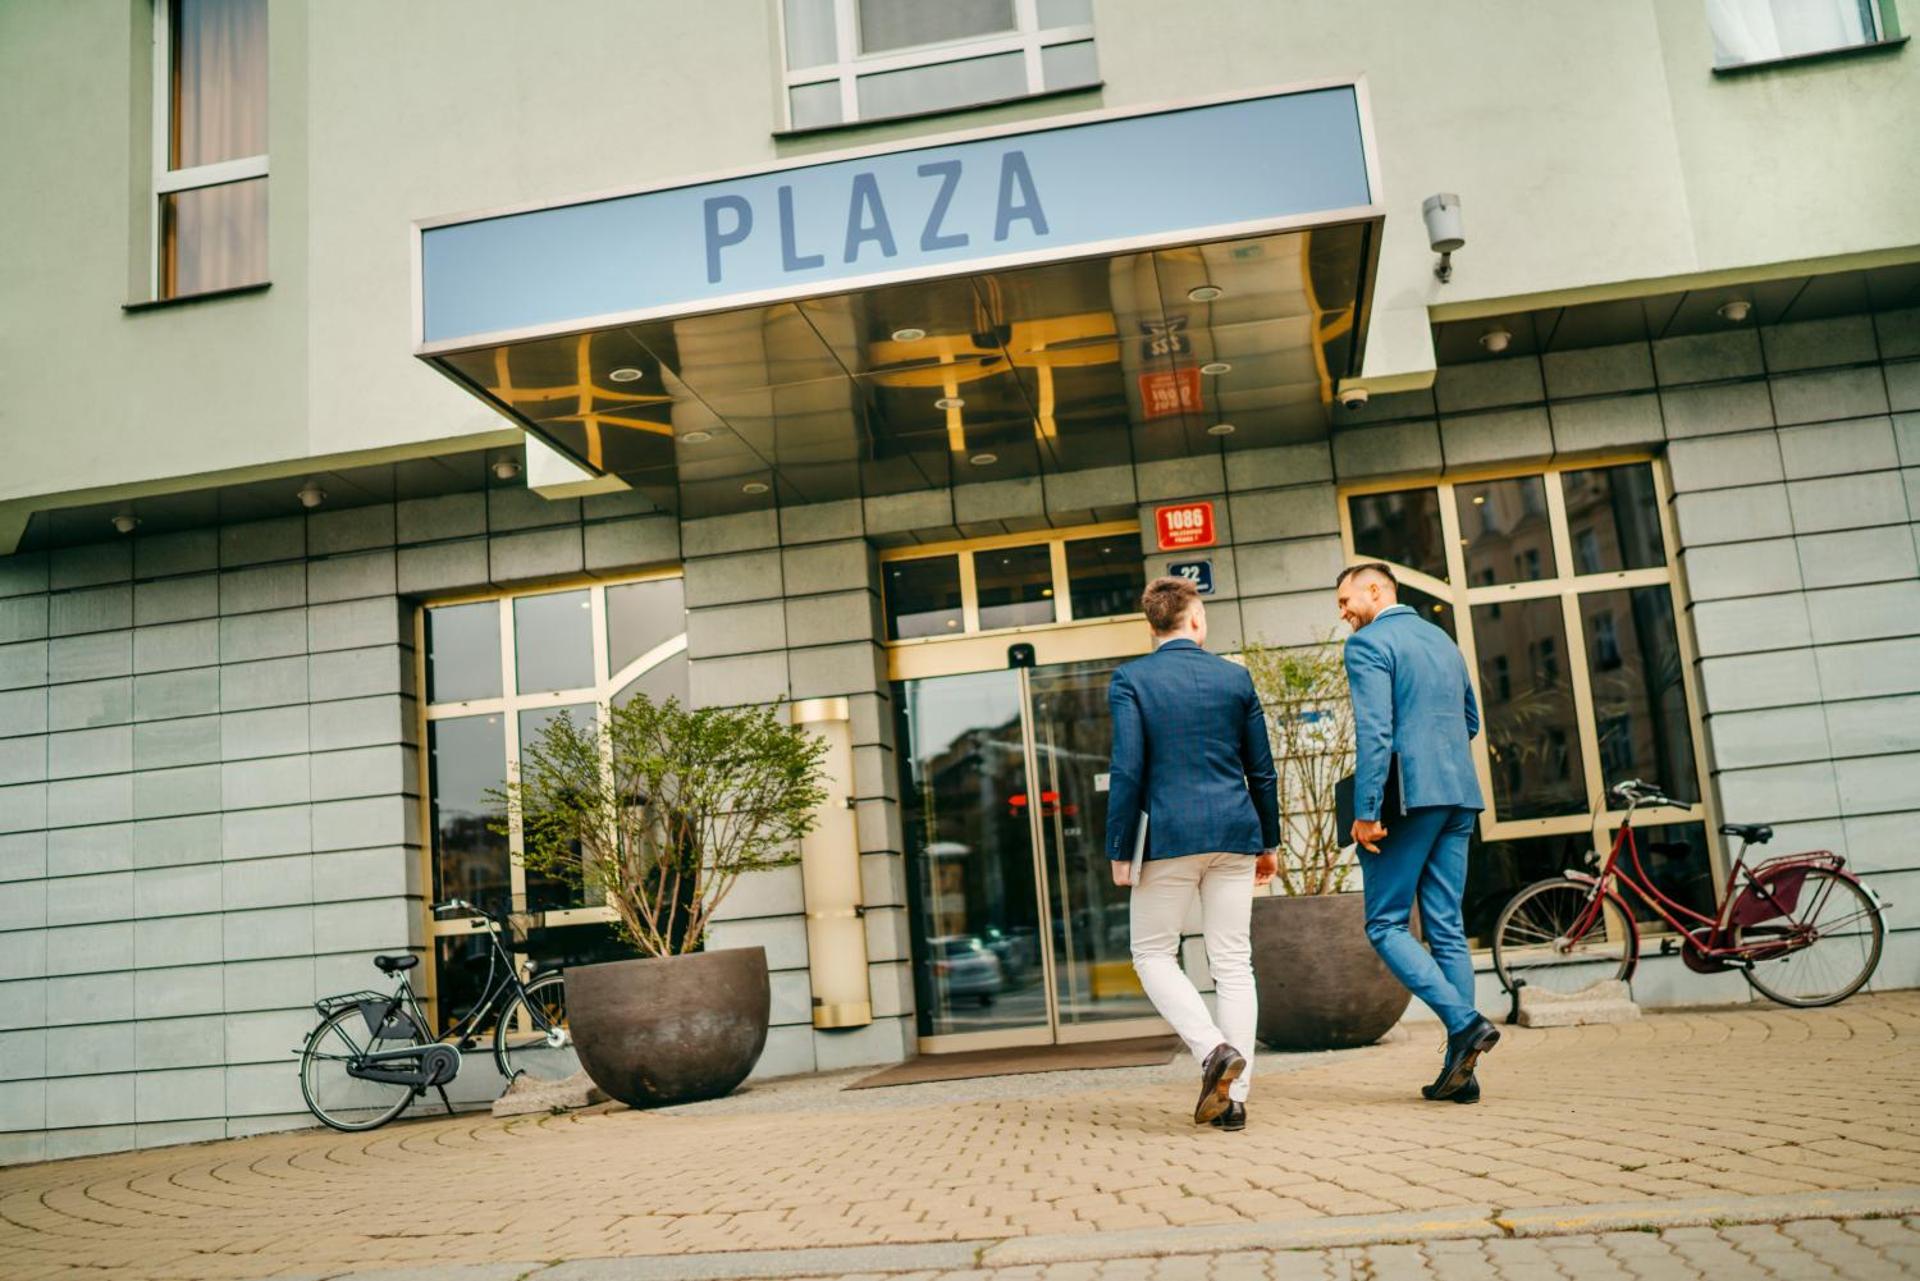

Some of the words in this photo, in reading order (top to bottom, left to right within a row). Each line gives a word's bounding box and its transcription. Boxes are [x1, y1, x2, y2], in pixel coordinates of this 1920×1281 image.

[704, 150, 1050, 284] PLAZA
[1164, 508, 1204, 530] 1086
[1180, 565, 1201, 582] 22
